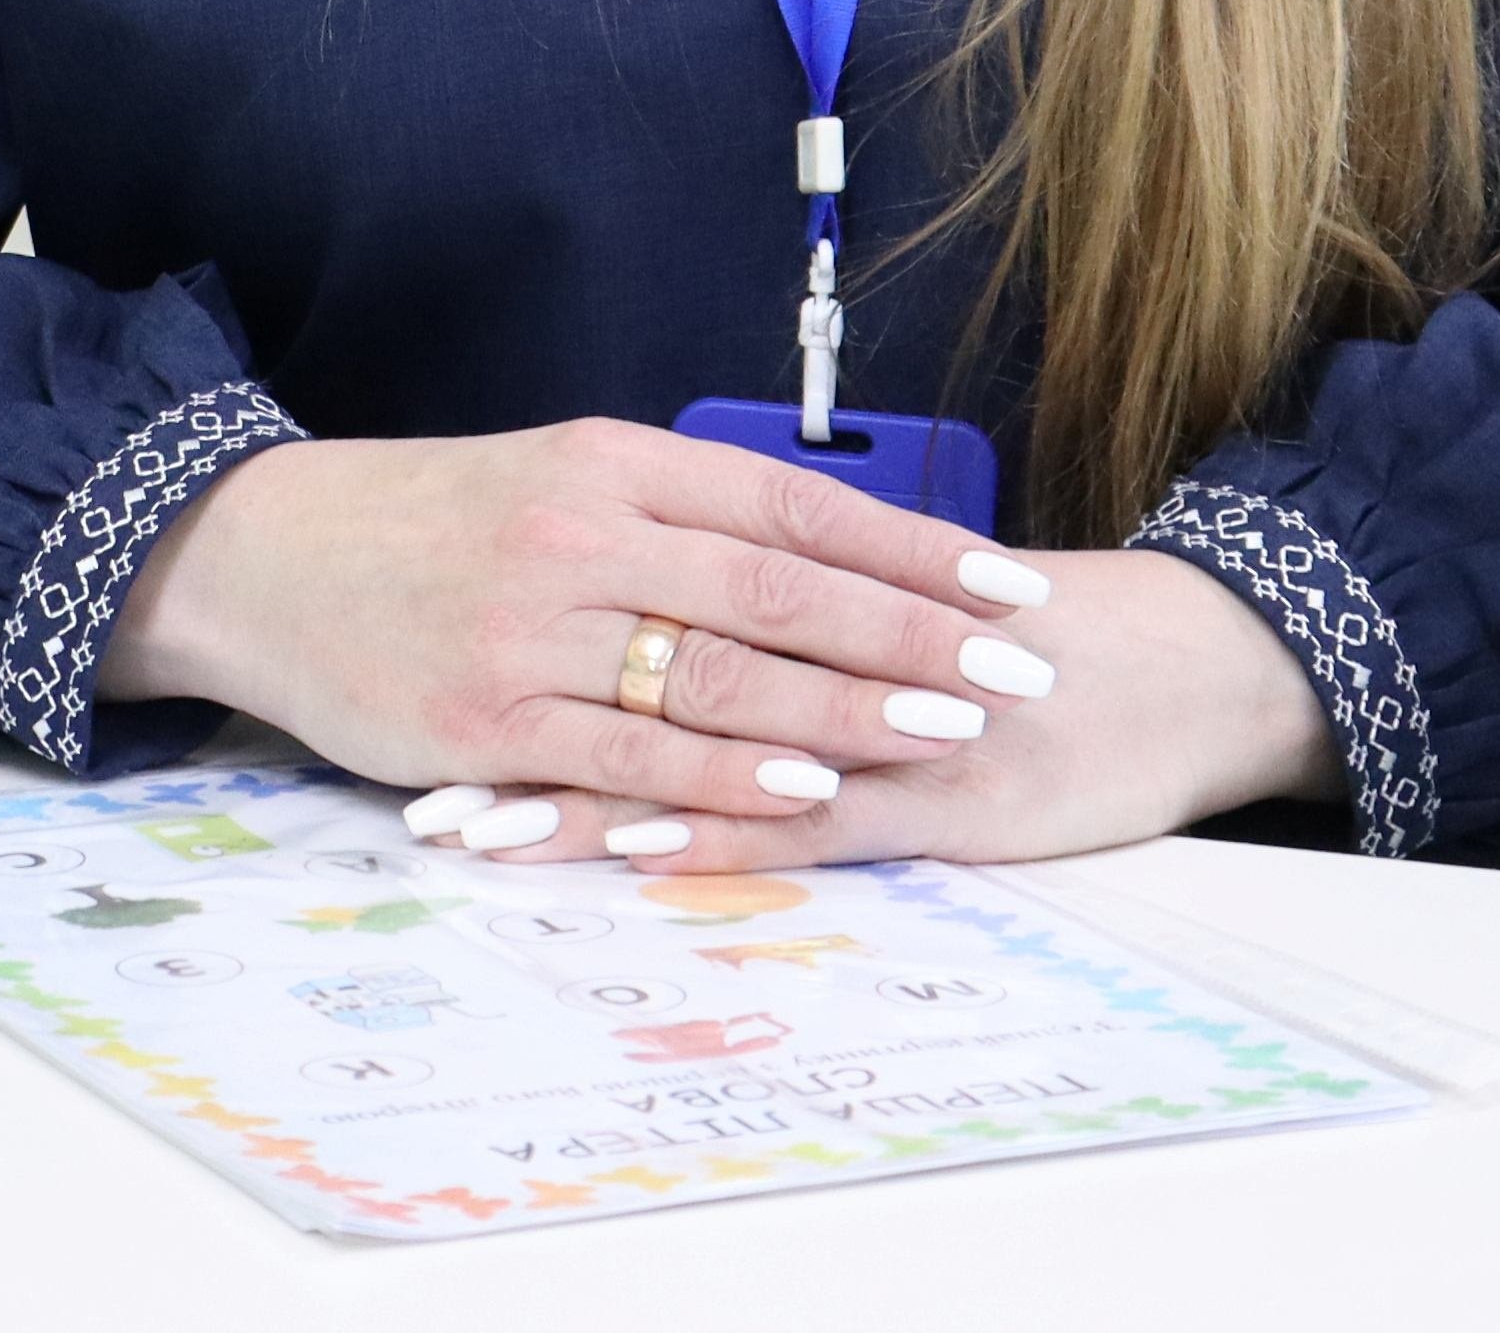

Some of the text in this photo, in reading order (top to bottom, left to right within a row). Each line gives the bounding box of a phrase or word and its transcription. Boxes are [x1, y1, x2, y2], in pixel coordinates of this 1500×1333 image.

[329, 855, 379, 874] А
[532, 917, 581, 935] Т
[154, 958, 207, 978] З
[589, 985, 649, 1005] О
[897, 979, 984, 1002] М
[331, 1059, 396, 1080] К
[608, 1067, 877, 1114] СЛОВА
[488, 1072, 1100, 1162] ПЕРША ЛІТЕРА
